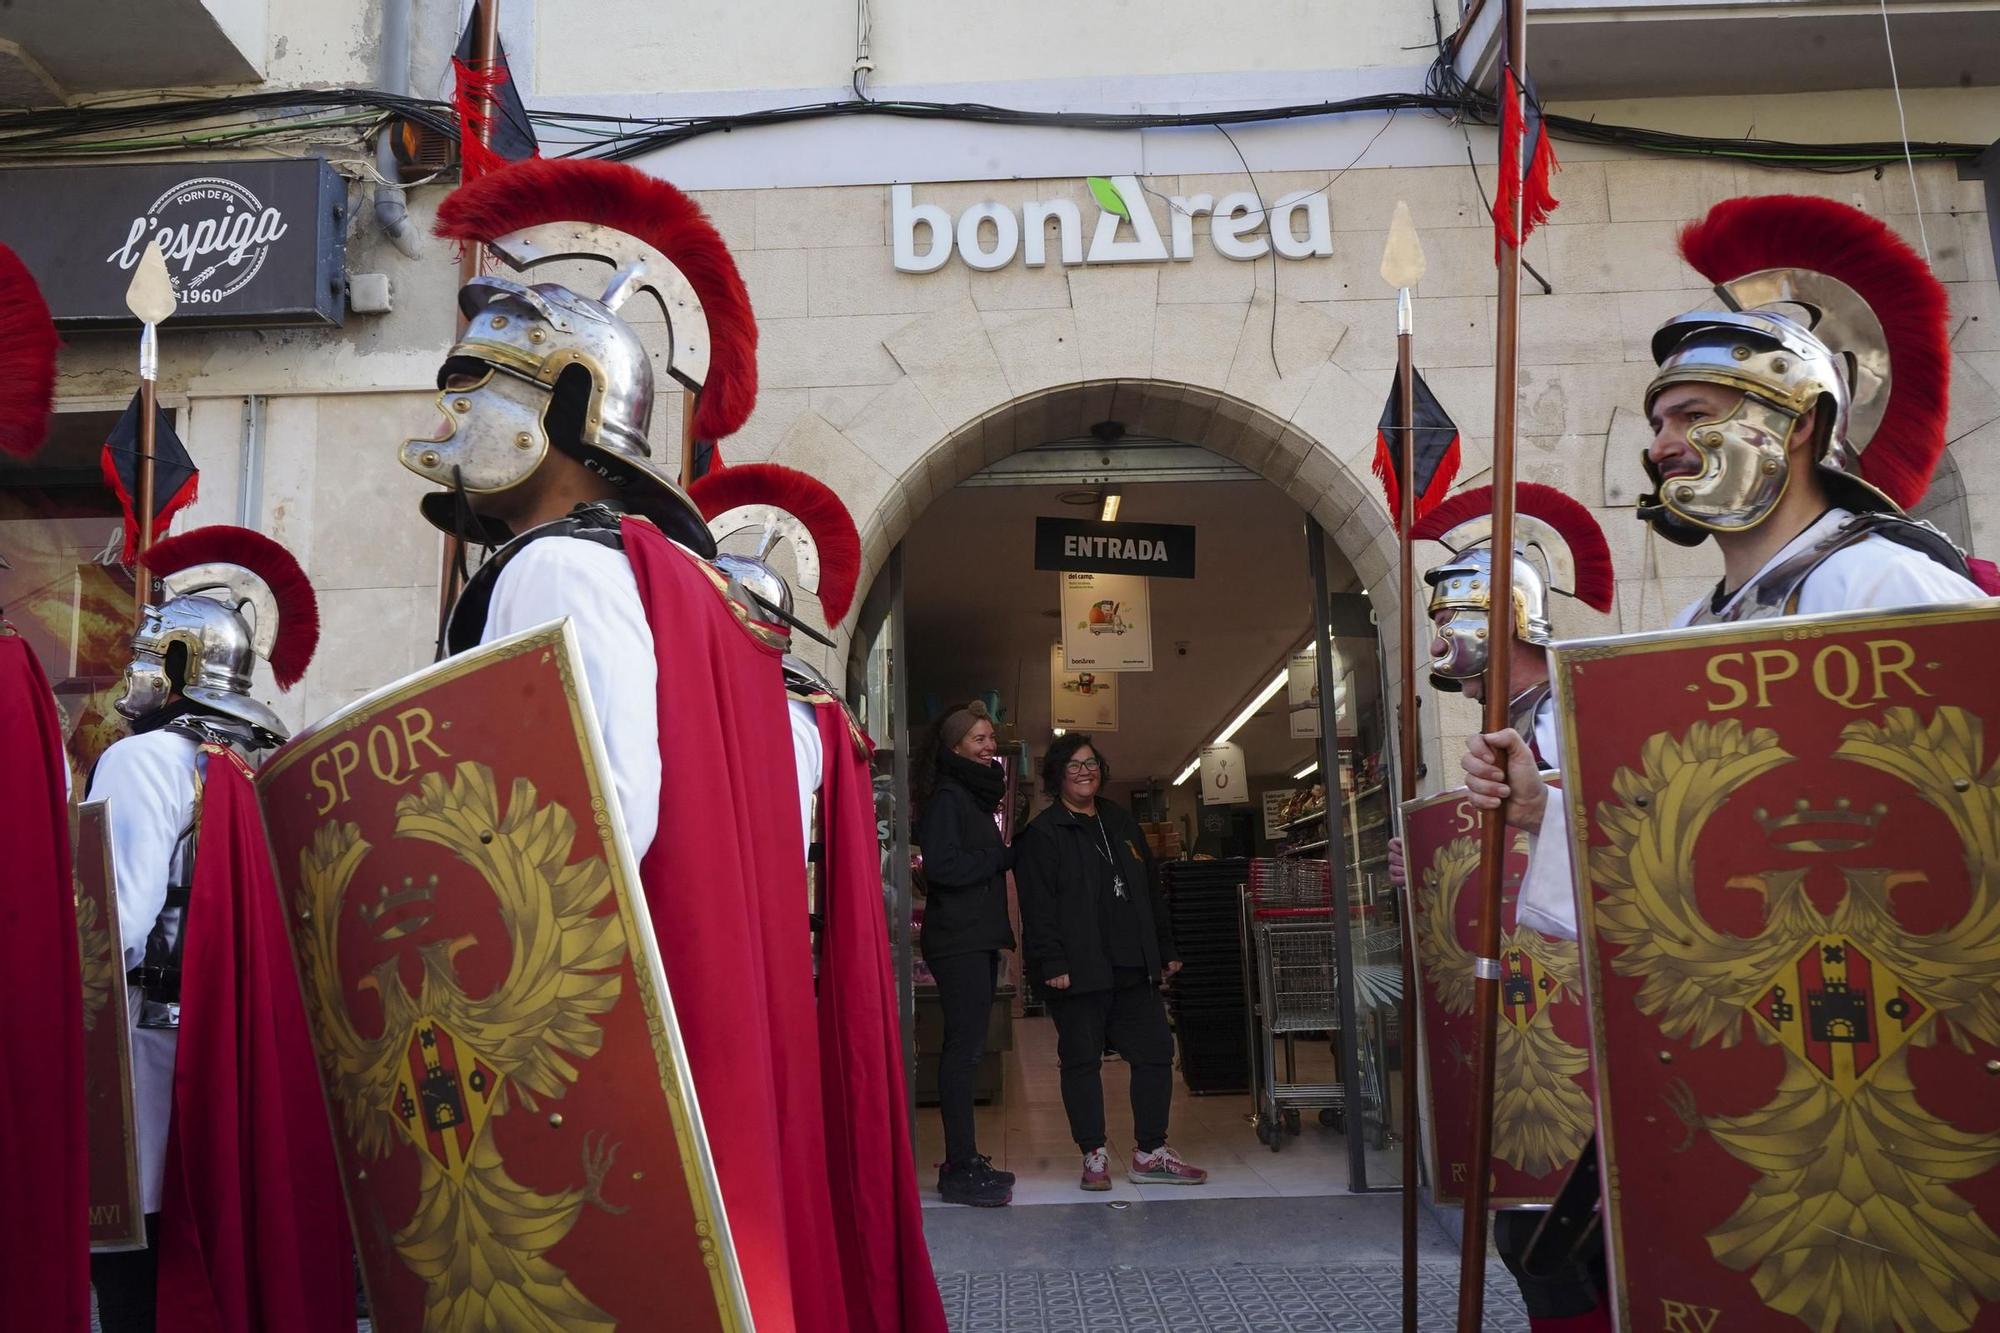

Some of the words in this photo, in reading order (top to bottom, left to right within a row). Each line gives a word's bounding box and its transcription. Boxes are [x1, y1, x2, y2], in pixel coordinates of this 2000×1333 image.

[177, 191, 206, 205] FORN
[208, 190, 222, 199] DE
[221, 192, 235, 204] PA
[106, 205, 288, 271] l'espiga
[181, 289, 222, 303] 1960
[1064, 535, 1168, 561] ENTRADA
[1705, 638, 1934, 712] SPQR
[310, 707, 451, 816] SPQR
